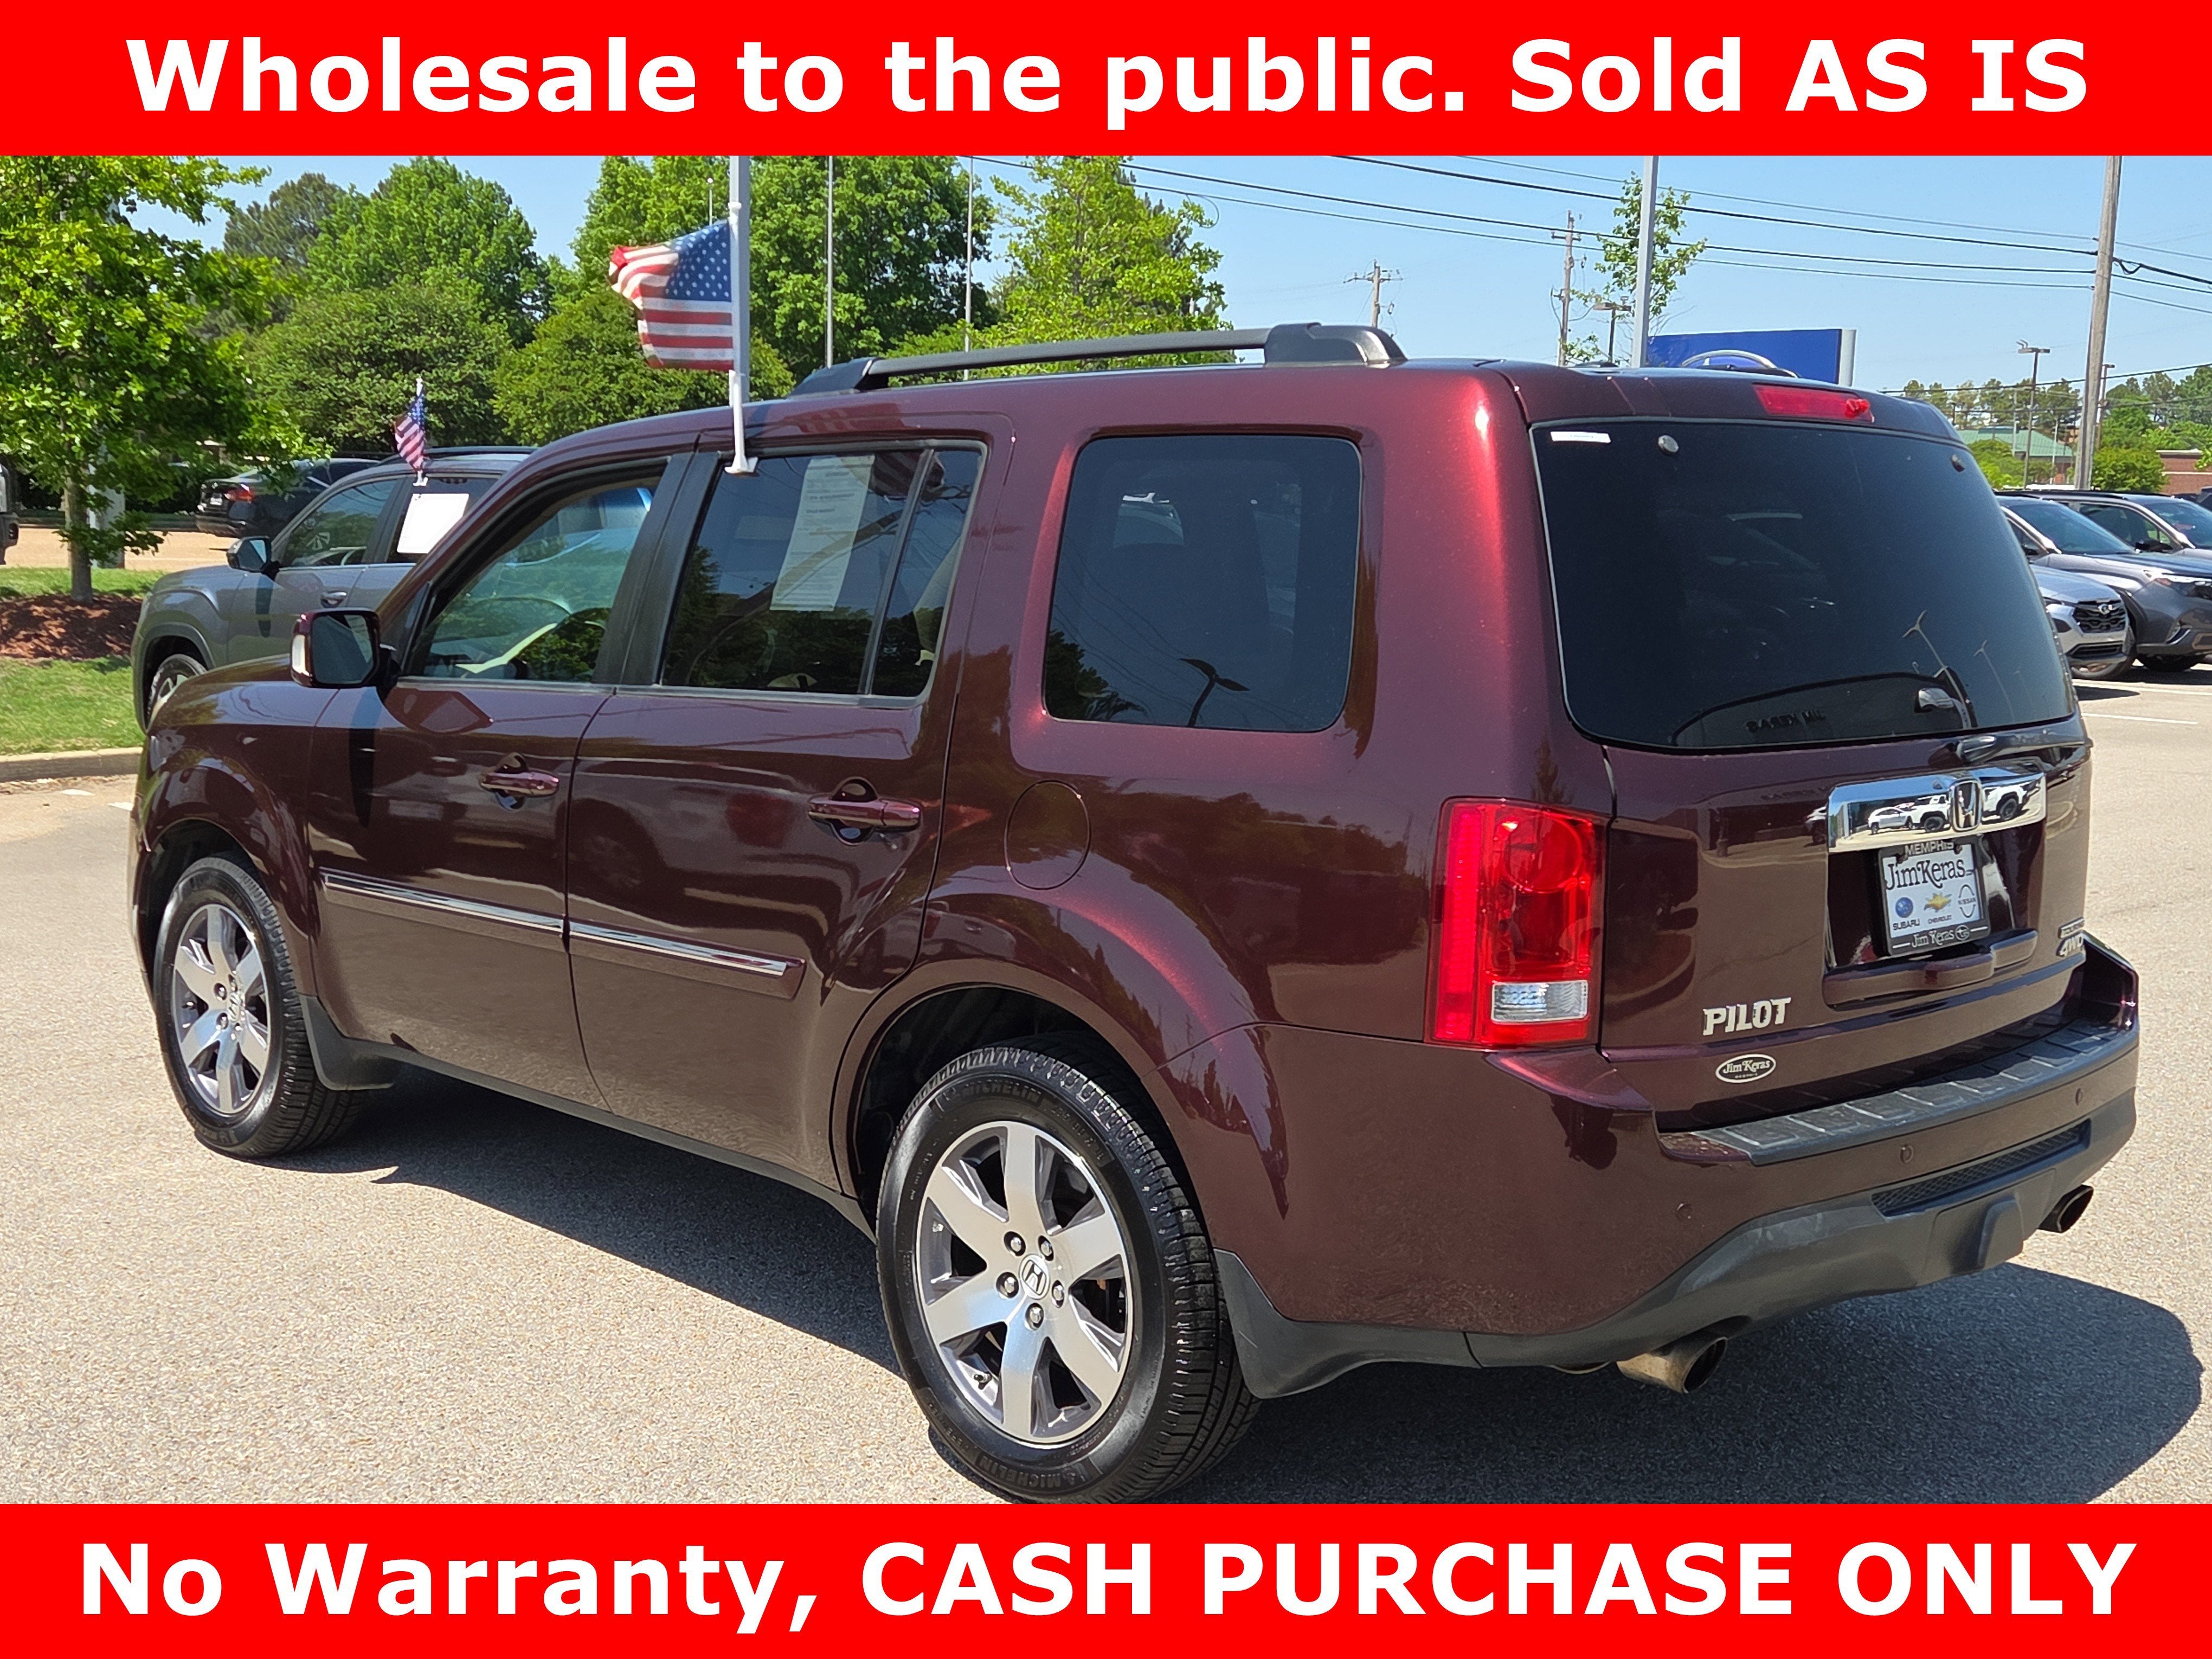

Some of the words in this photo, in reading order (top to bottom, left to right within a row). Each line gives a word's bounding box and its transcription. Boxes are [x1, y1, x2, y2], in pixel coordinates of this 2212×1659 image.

[1905, 840, 1954, 856] MEMPHIS
[1893, 919, 1920, 930] SUBARU
[1912, 934, 1929, 948] Jim
[1929, 930, 1954, 946] Keras
[1702, 997, 1791, 1036] PILOT
[1723, 1063, 1742, 1073] Jim
[1742, 1060, 1770, 1072] Keras
[962, 1079, 1041, 1103] MICHELIN
[979, 1454, 1061, 1488] MICHELIN
